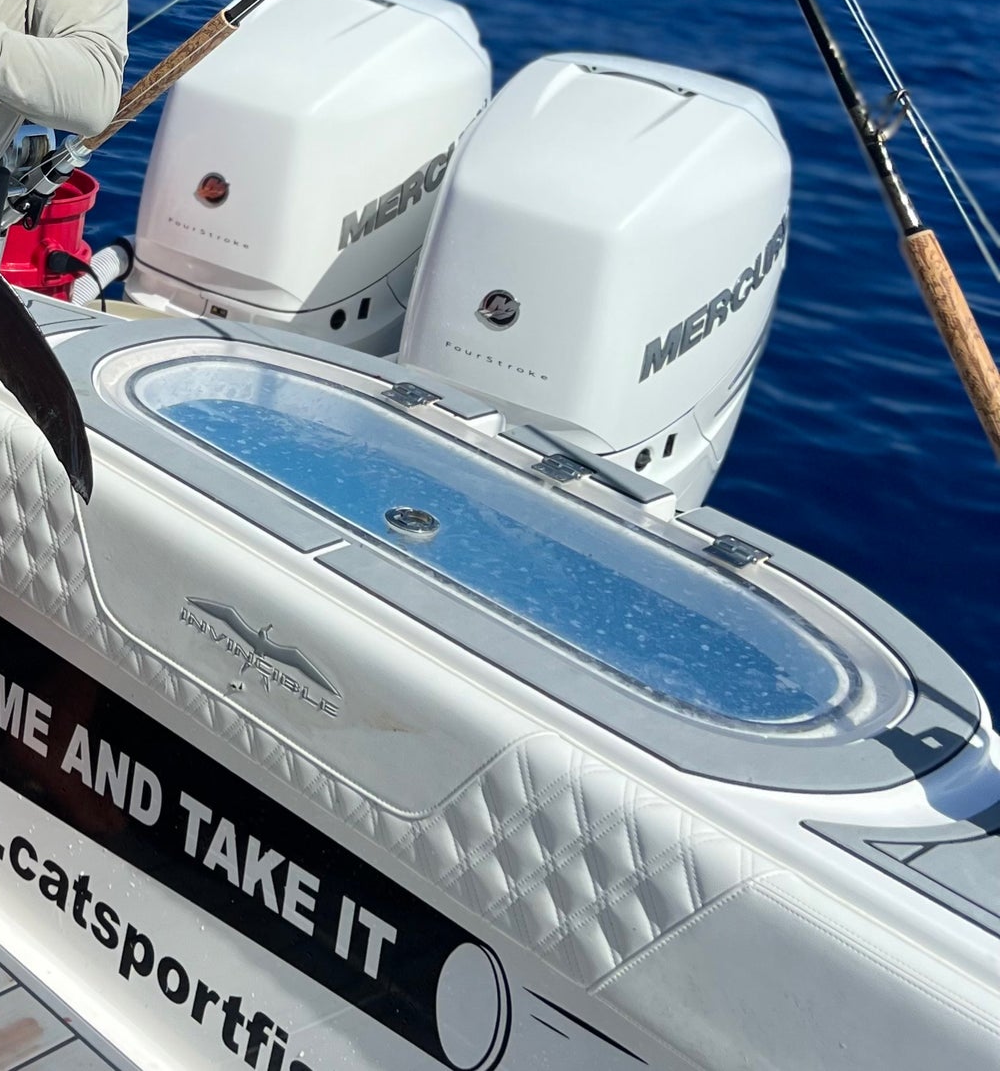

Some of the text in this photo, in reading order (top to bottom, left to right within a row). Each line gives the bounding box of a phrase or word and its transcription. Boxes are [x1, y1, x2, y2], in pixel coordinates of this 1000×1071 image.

[445, 340, 549, 380] FourStroke
[180, 607, 340, 718] INVINCIBLE
[60, 724, 162, 826] AND
[179, 790, 321, 937] TAKE
[334, 895, 397, 980] IT
